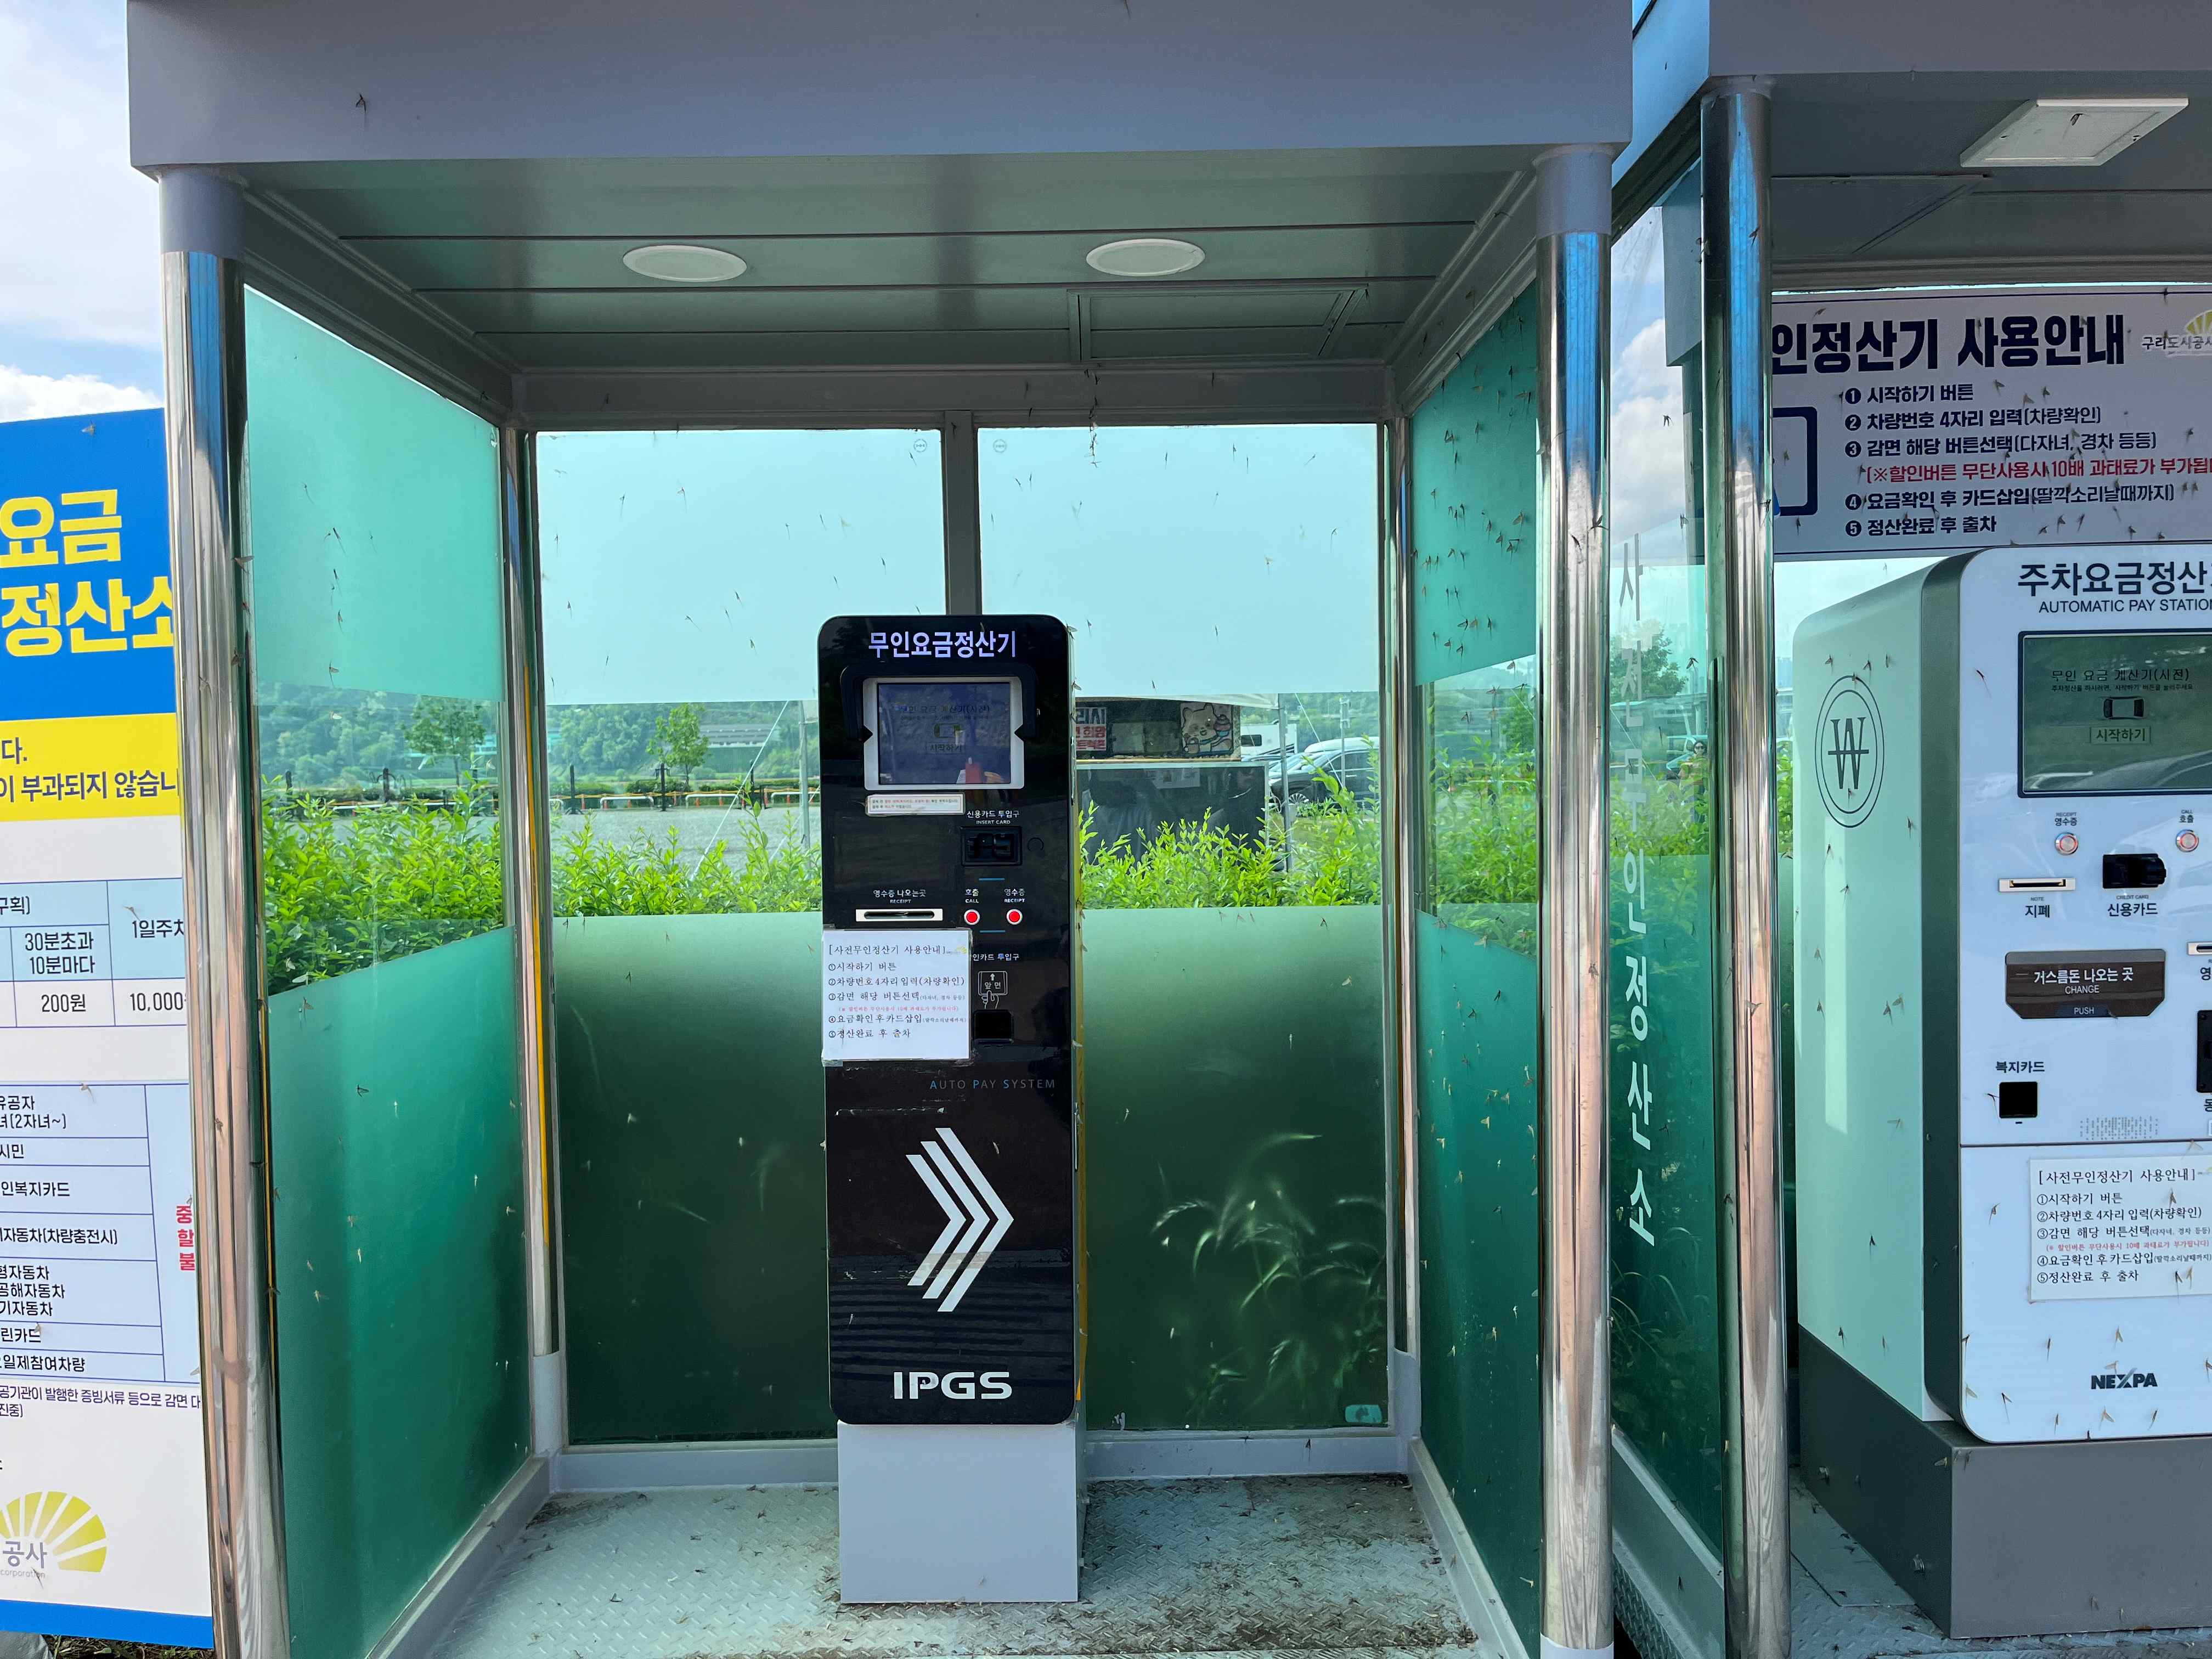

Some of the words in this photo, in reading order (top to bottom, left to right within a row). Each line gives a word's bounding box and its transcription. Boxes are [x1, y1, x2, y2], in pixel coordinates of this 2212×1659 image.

[1772, 319, 1938, 375] 인정산기
[1957, 314, 2124, 368] 사용안내
[1867, 385, 1934, 404] 시작하기
[1940, 383, 1973, 401] 버튼
[1867, 412, 1934, 431] 차량번호
[1940, 410, 1983, 428] 4자리
[1990, 407, 2101, 426] 입력(차량확인)
[1867, 439, 1900, 456] 감면
[1906, 438, 1941, 455] 해당
[2081, 432, 2114, 449] 경차
[2119, 432, 2157, 449] 등등)
[1962, 461, 2047, 479] 무단사용시
[2052, 460, 2084, 477] 10배
[2089, 458, 2155, 476] 과태료가
[1867, 492, 1934, 509] 요금확인
[1940, 490, 1957, 507] 후
[0, 489, 122, 568] 요금
[1867, 517, 1934, 536] 정산완료
[1940, 516, 1957, 533] 후
[1962, 515, 1997, 533] 출차
[2018, 561, 2212, 597] 주차요금정산
[2039, 600, 2125, 613] AUTOMATIC
[2129, 599, 2155, 611] PAY
[2, 576, 173, 657] 정산소
[868, 630, 1016, 658] 무인요금정산기
[2052, 670, 2076, 682] 무인
[2083, 669, 2108, 681] 요금
[2096, 727, 2146, 742] 시작하기
[21, 771, 108, 802] 부과되지
[967, 810, 996, 819] 신용카드
[2055, 817, 2077, 826] 영수증
[2179, 815, 2193, 823] 호출
[873, 889, 895, 898] 영수증
[964, 888, 979, 897] 호출
[1004, 888, 1025, 896] 영수증
[2025, 904, 2050, 918] 지폐
[2107, 903, 2158, 917] 신용카드
[25, 931, 94, 951] 30분초과
[30, 955, 96, 975] 10분마다
[997, 953, 1020, 961] 투입구
[879, 962, 897, 971] 버튼
[2034, 969, 2081, 985] 거스름돈
[2085, 968, 2118, 983] 나오는
[2122, 967, 2134, 982] 곳
[860, 991, 878, 1001] 해당
[2064, 985, 2100, 995] CHANGE
[41, 993, 86, 1013] 200원
[130, 991, 187, 1012] 10,000
[2074, 1007, 2095, 1015] PUSH
[879, 1029, 887, 1038] 후
[1995, 1061, 2045, 1074] 복지카드
[930, 1079, 966, 1090] AUTO
[973, 1079, 997, 1089] PAY
[1003, 1079, 1055, 1089] SYSTEM
[1, 1181, 71, 1197] 인복지카드
[2101, 1192, 2123, 1204] 버튼
[2096, 1209, 2124, 1221] 4자리
[0, 1227, 118, 1245] 자동차(차량충전시)
[2077, 1226, 2100, 1239] 해당
[2096, 1253, 2107, 1265] 후
[2100, 1270, 2111, 1283] 후
[2117, 1269, 2139, 1282] 출차
[0, 1282, 66, 1299] 공해자동차
[1, 1327, 41, 1343] 린카드
[0, 1354, 86, 1373] 일제참여차량
[893, 1372, 1013, 1400] IPGS
[2091, 1367, 2158, 1390] NEXPA
[0, 1385, 42, 1401] 공기관이
[46, 1387, 78, 1402] 발행한
[81, 1389, 125, 1405] 증빙서류
[128, 1391, 161, 1407] 등으로
[165, 1393, 188, 1408] 감면
[3, 1541, 48, 1569] 공사
